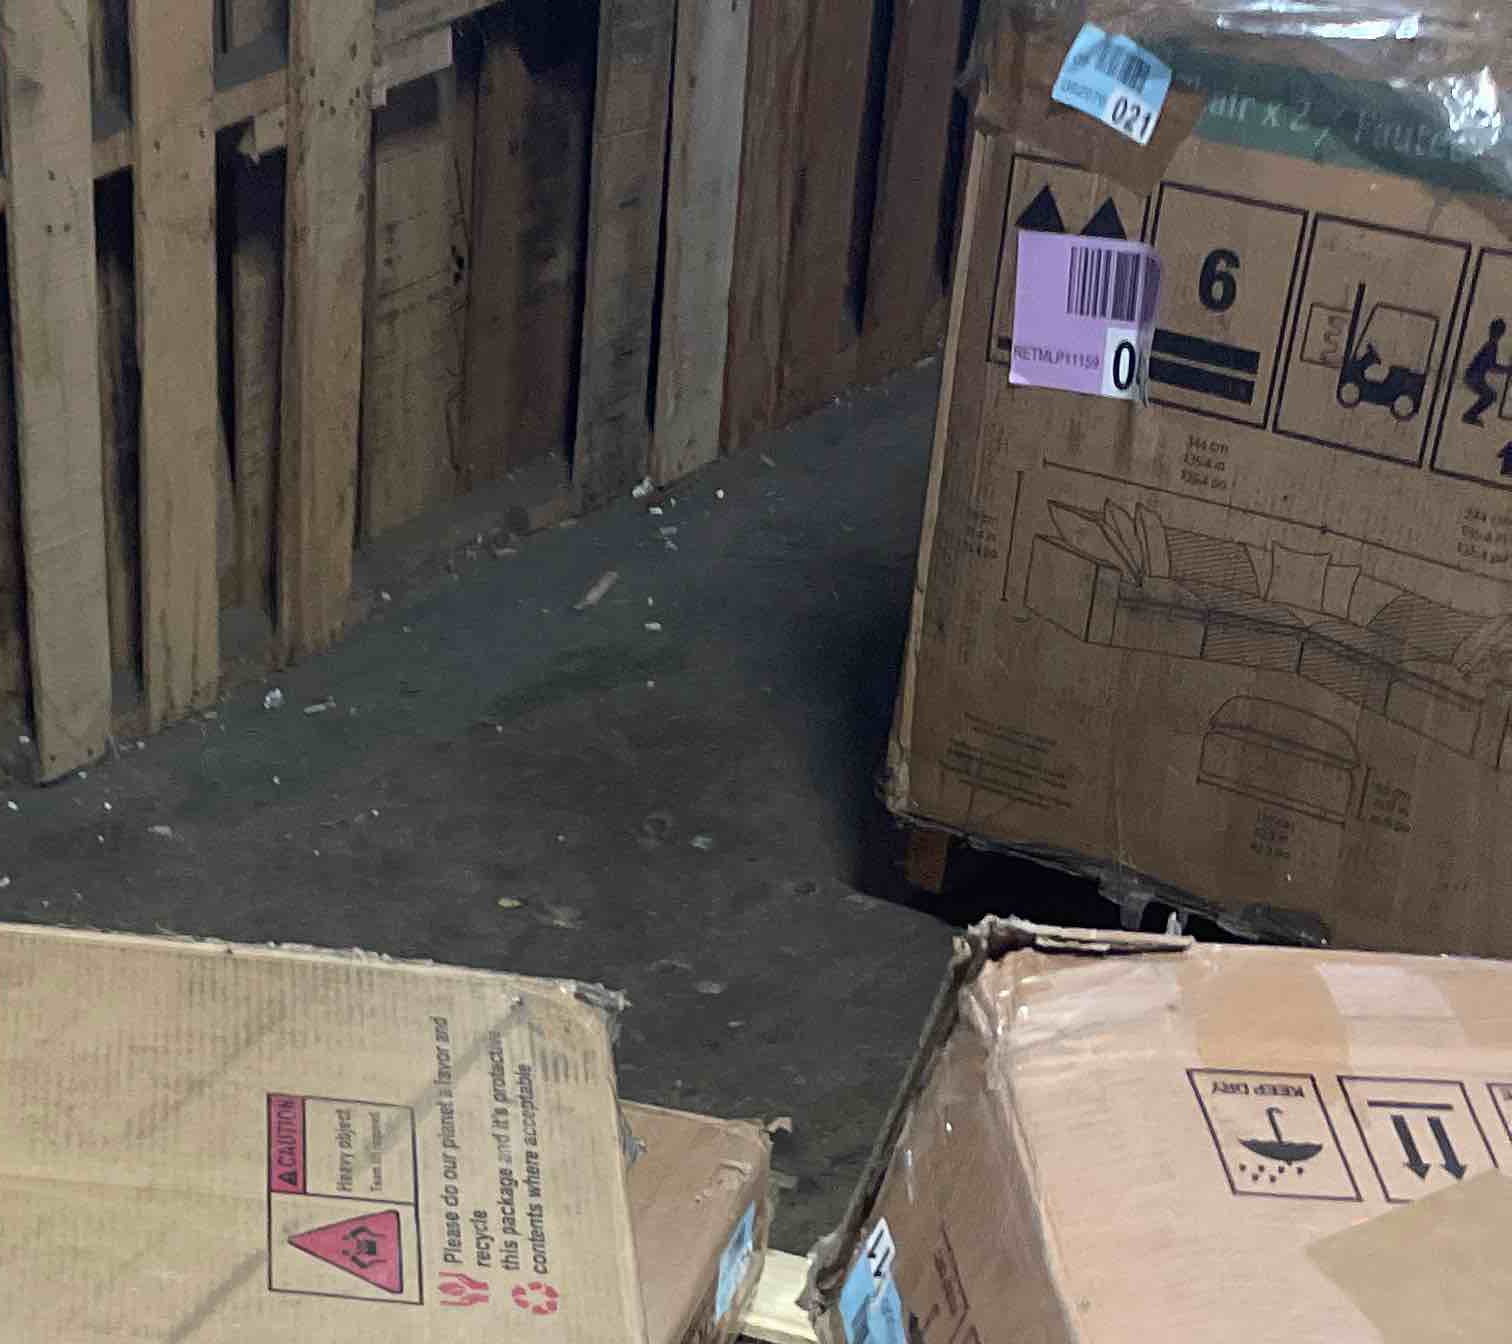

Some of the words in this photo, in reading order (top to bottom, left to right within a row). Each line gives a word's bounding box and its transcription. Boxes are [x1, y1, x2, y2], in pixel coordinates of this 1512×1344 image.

[1112, 95, 1152, 137] 021
[1199, 248, 1240, 312] 6
[430, 1015, 448, 1042] and
[434, 1047, 453, 1086] favor
[515, 1063, 539, 1146] acceptable
[1210, 1080, 1250, 1096] DRY
[1253, 1083, 1305, 1098] KEEP
[277, 1100, 296, 1168] CAUTION
[438, 1101, 459, 1149] planet
[442, 1153, 458, 1180] our
[493, 1133, 511, 1163] and
[336, 1152, 352, 1192] Heavy
[522, 1151, 541, 1198] where
[440, 1184, 459, 1207] do
[498, 1168, 521, 1236] package
[443, 1212, 463, 1264] Please
[470, 1209, 494, 1268] recycle
[502, 1240, 520, 1271] this
[527, 1203, 548, 1275] contents
